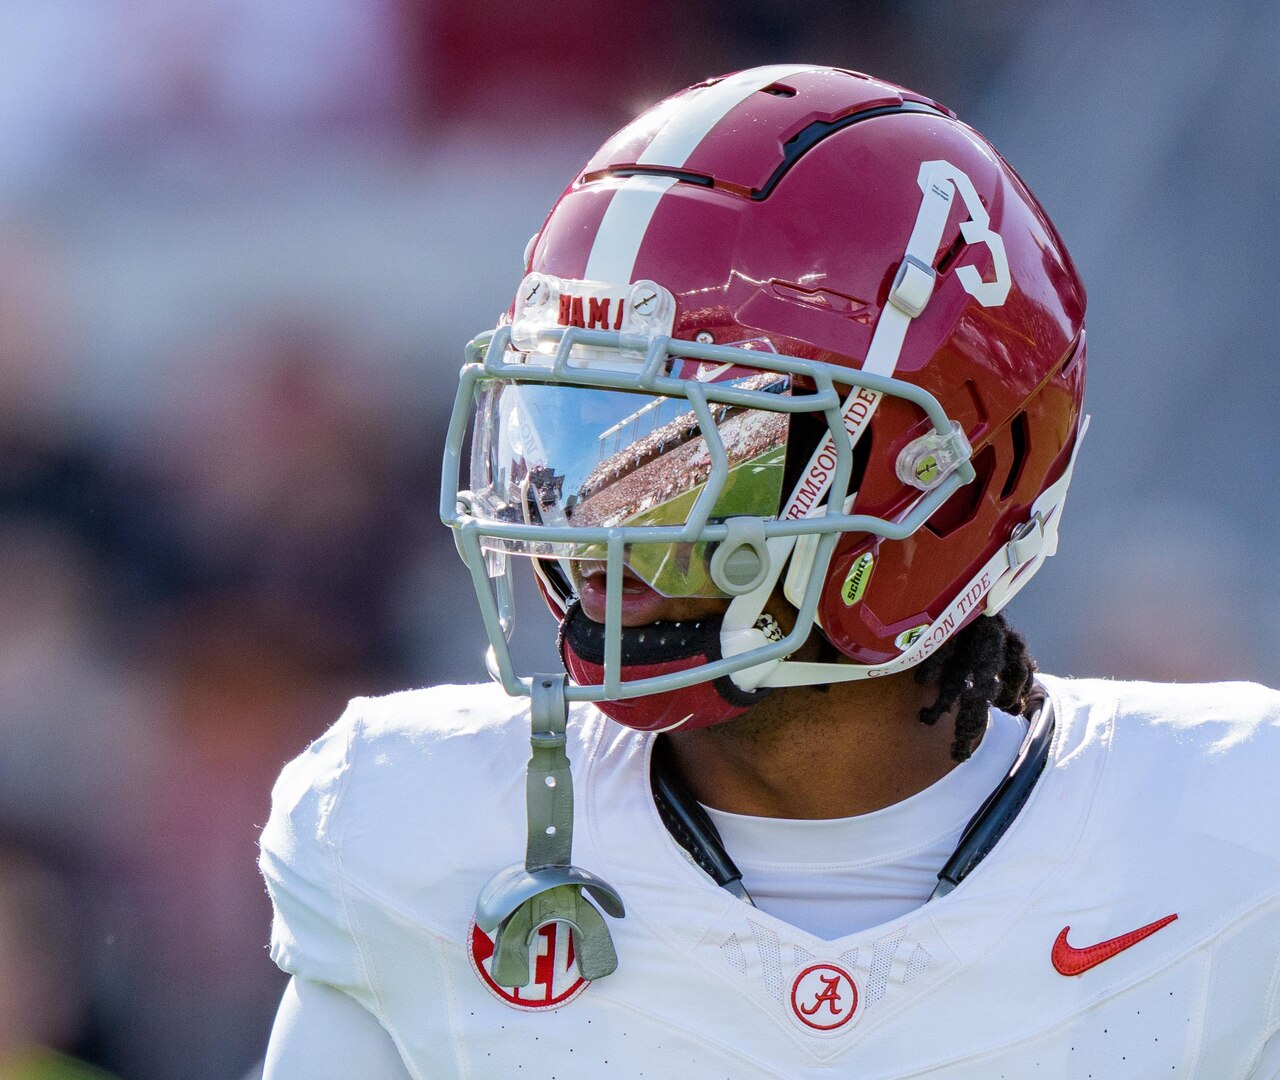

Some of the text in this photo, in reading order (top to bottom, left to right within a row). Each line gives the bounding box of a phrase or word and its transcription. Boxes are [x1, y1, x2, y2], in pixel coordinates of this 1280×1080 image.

[917, 160, 1012, 308] 3
[786, 438, 839, 521] RIMSON
[956, 571, 991, 616] TIDE
[800, 974, 842, 1015] A
